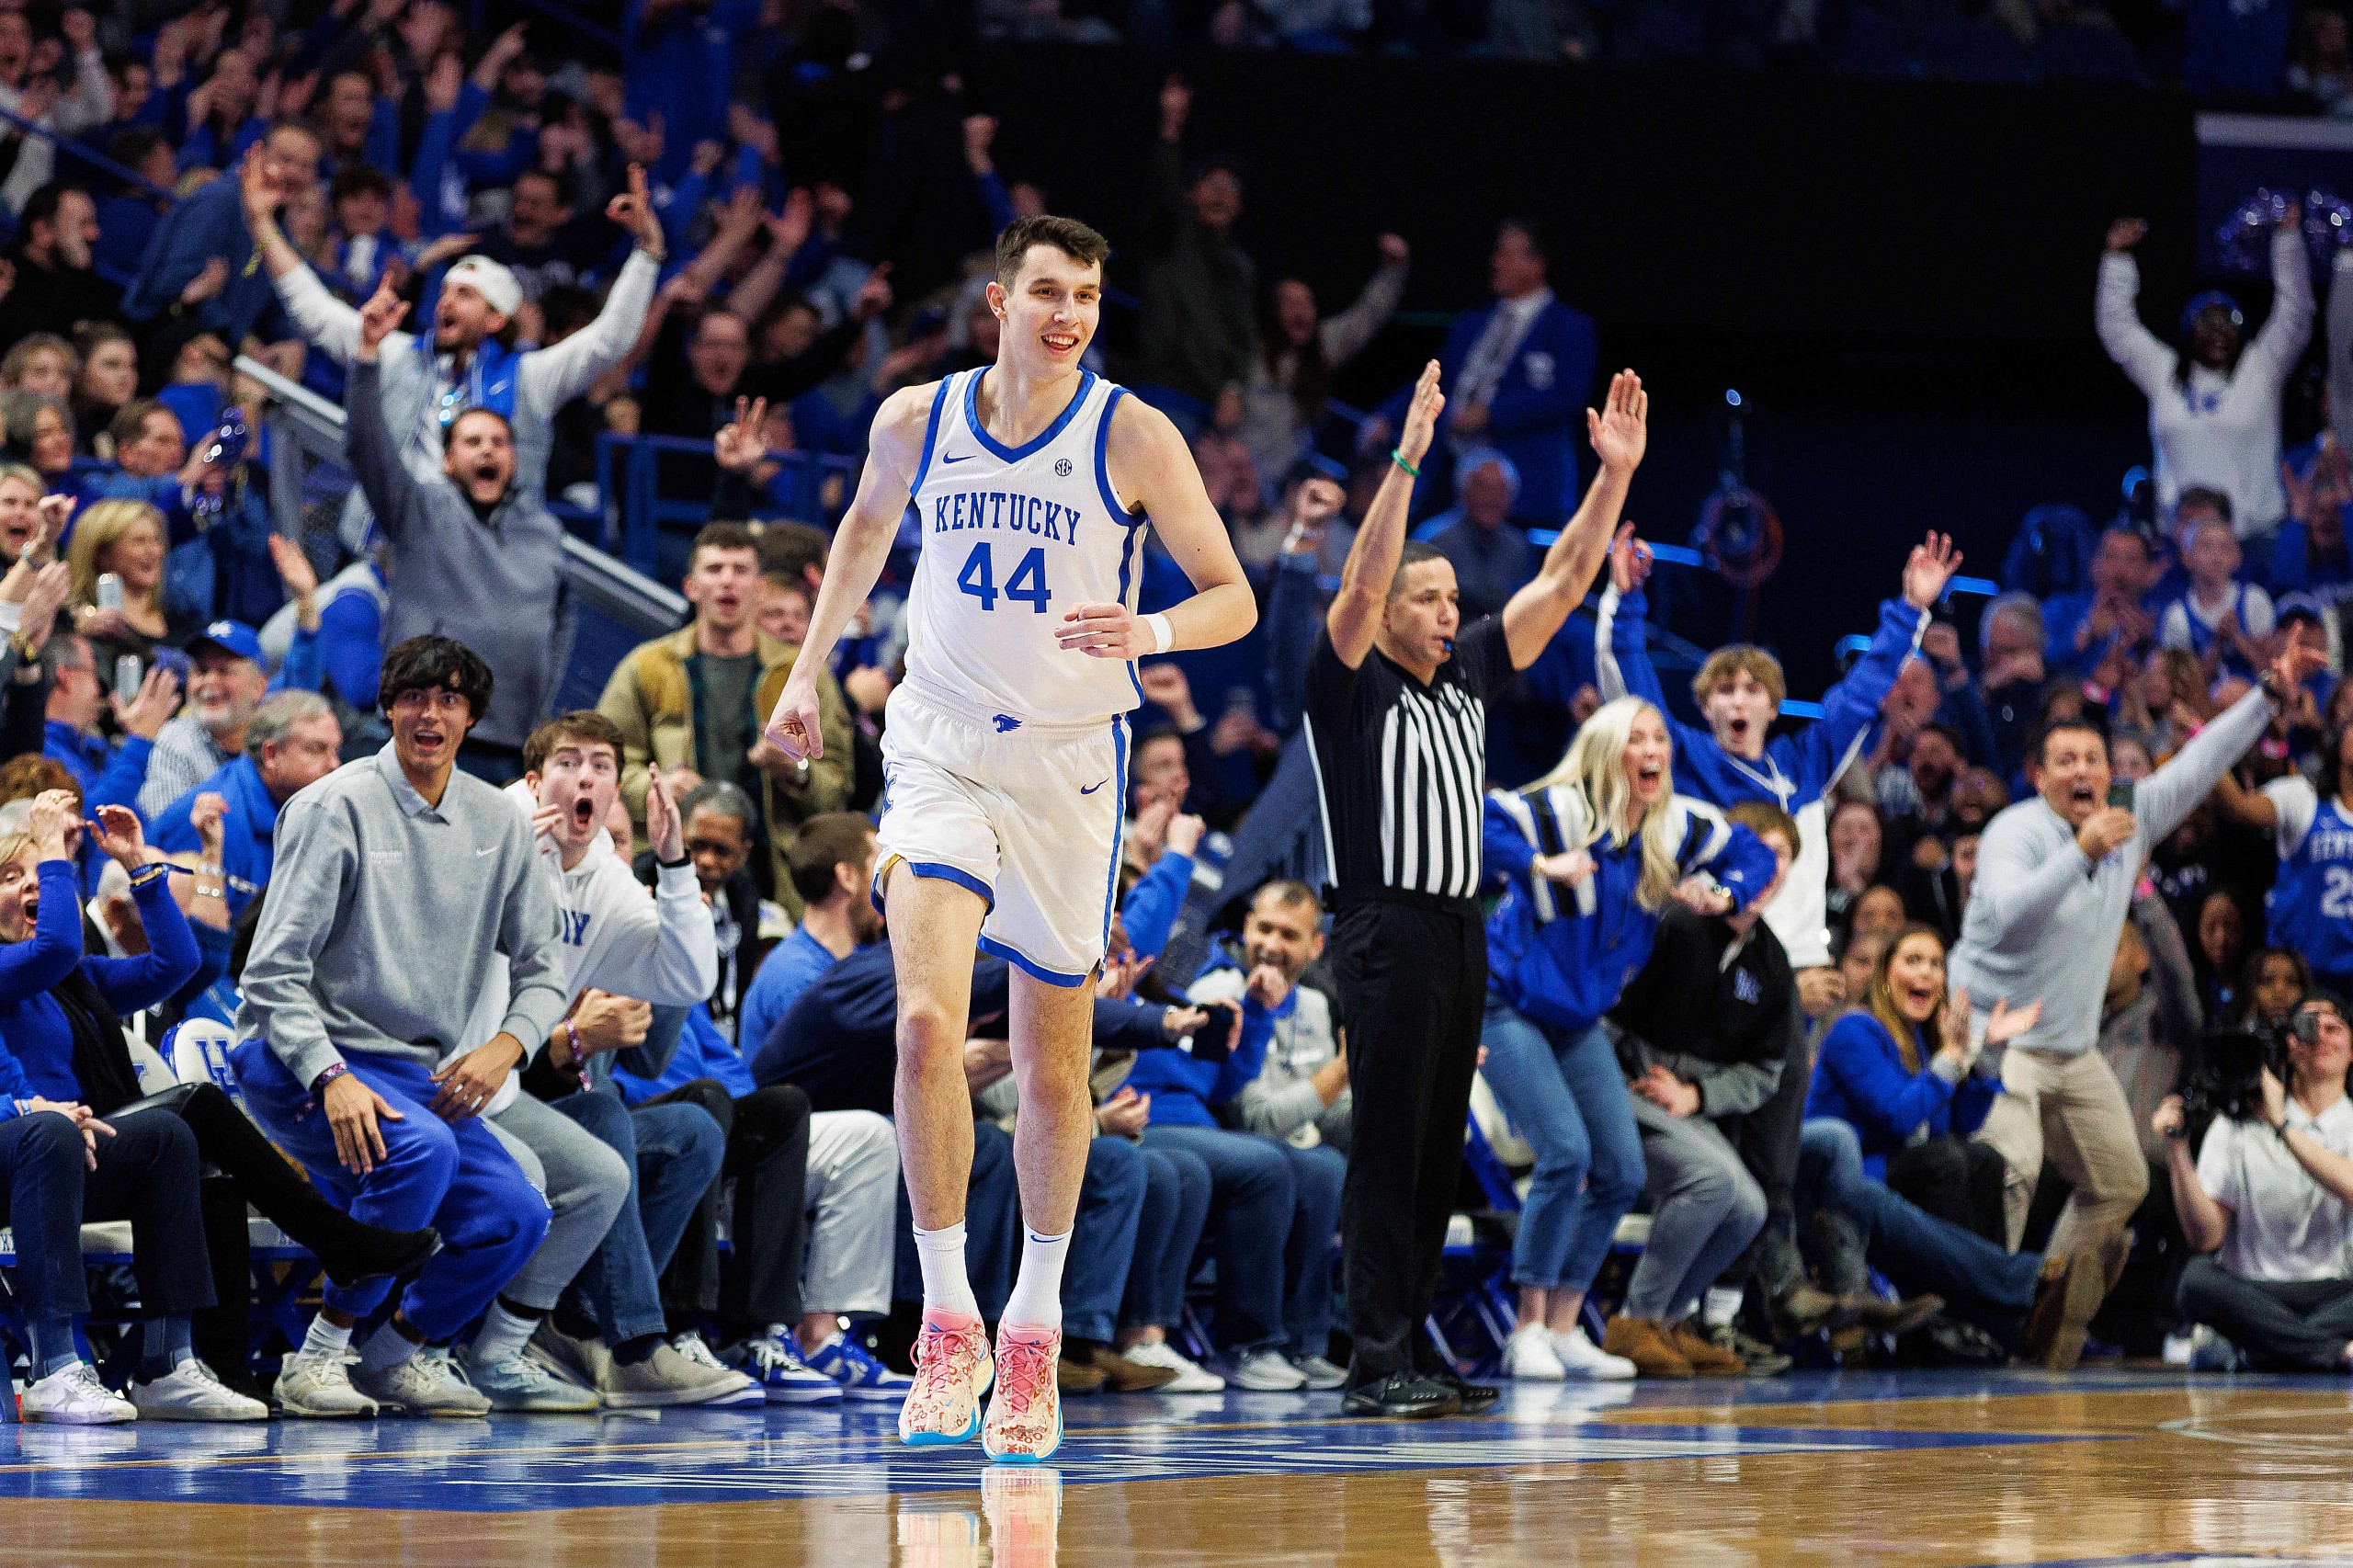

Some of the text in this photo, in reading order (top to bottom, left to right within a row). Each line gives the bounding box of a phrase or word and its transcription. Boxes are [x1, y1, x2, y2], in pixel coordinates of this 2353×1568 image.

[1055, 459, 1073, 476] SEC
[935, 492, 1081, 546] KENTUCKY
[957, 541, 1051, 614] 44
